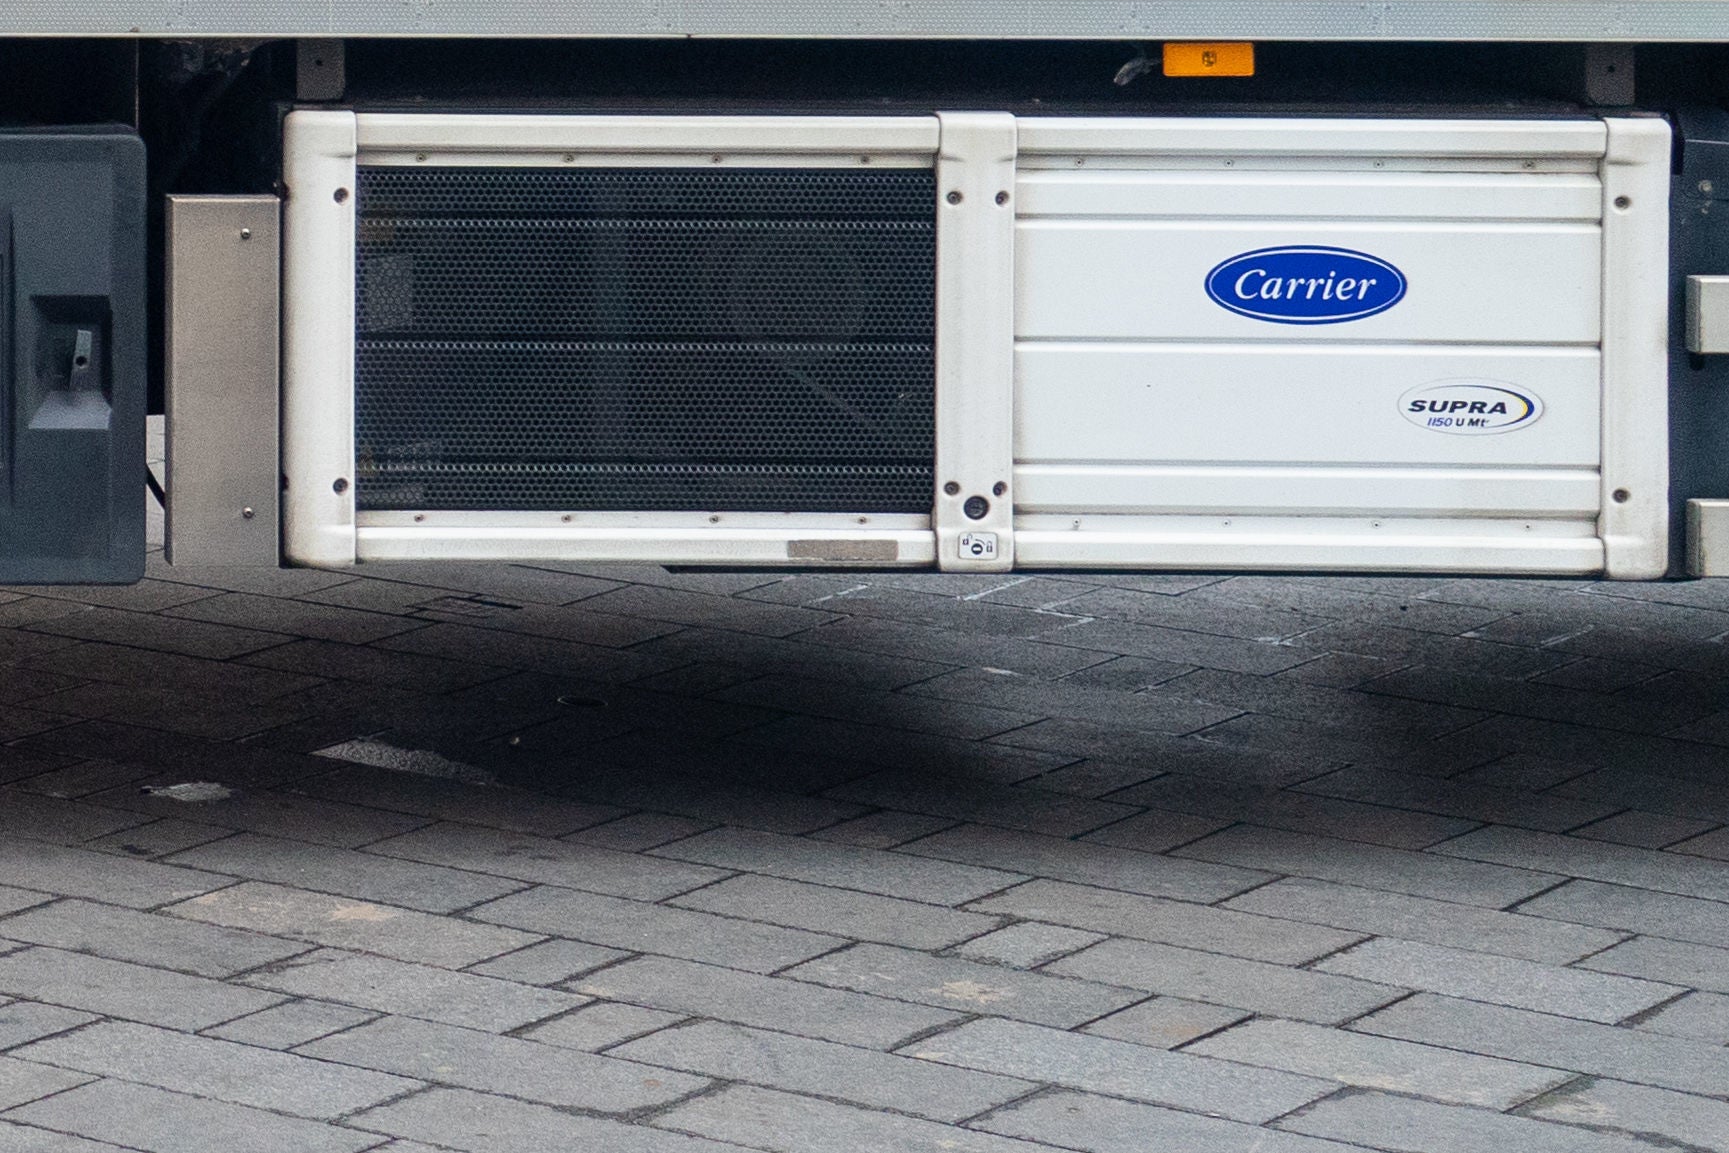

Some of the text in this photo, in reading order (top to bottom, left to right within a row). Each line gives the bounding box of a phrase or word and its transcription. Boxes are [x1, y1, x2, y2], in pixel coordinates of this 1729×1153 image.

[1234, 268, 1377, 301] Carrier
[1407, 399, 1508, 415] SUPRA
[1426, 417, 1453, 427] 1150
[1455, 417, 1465, 428] U
